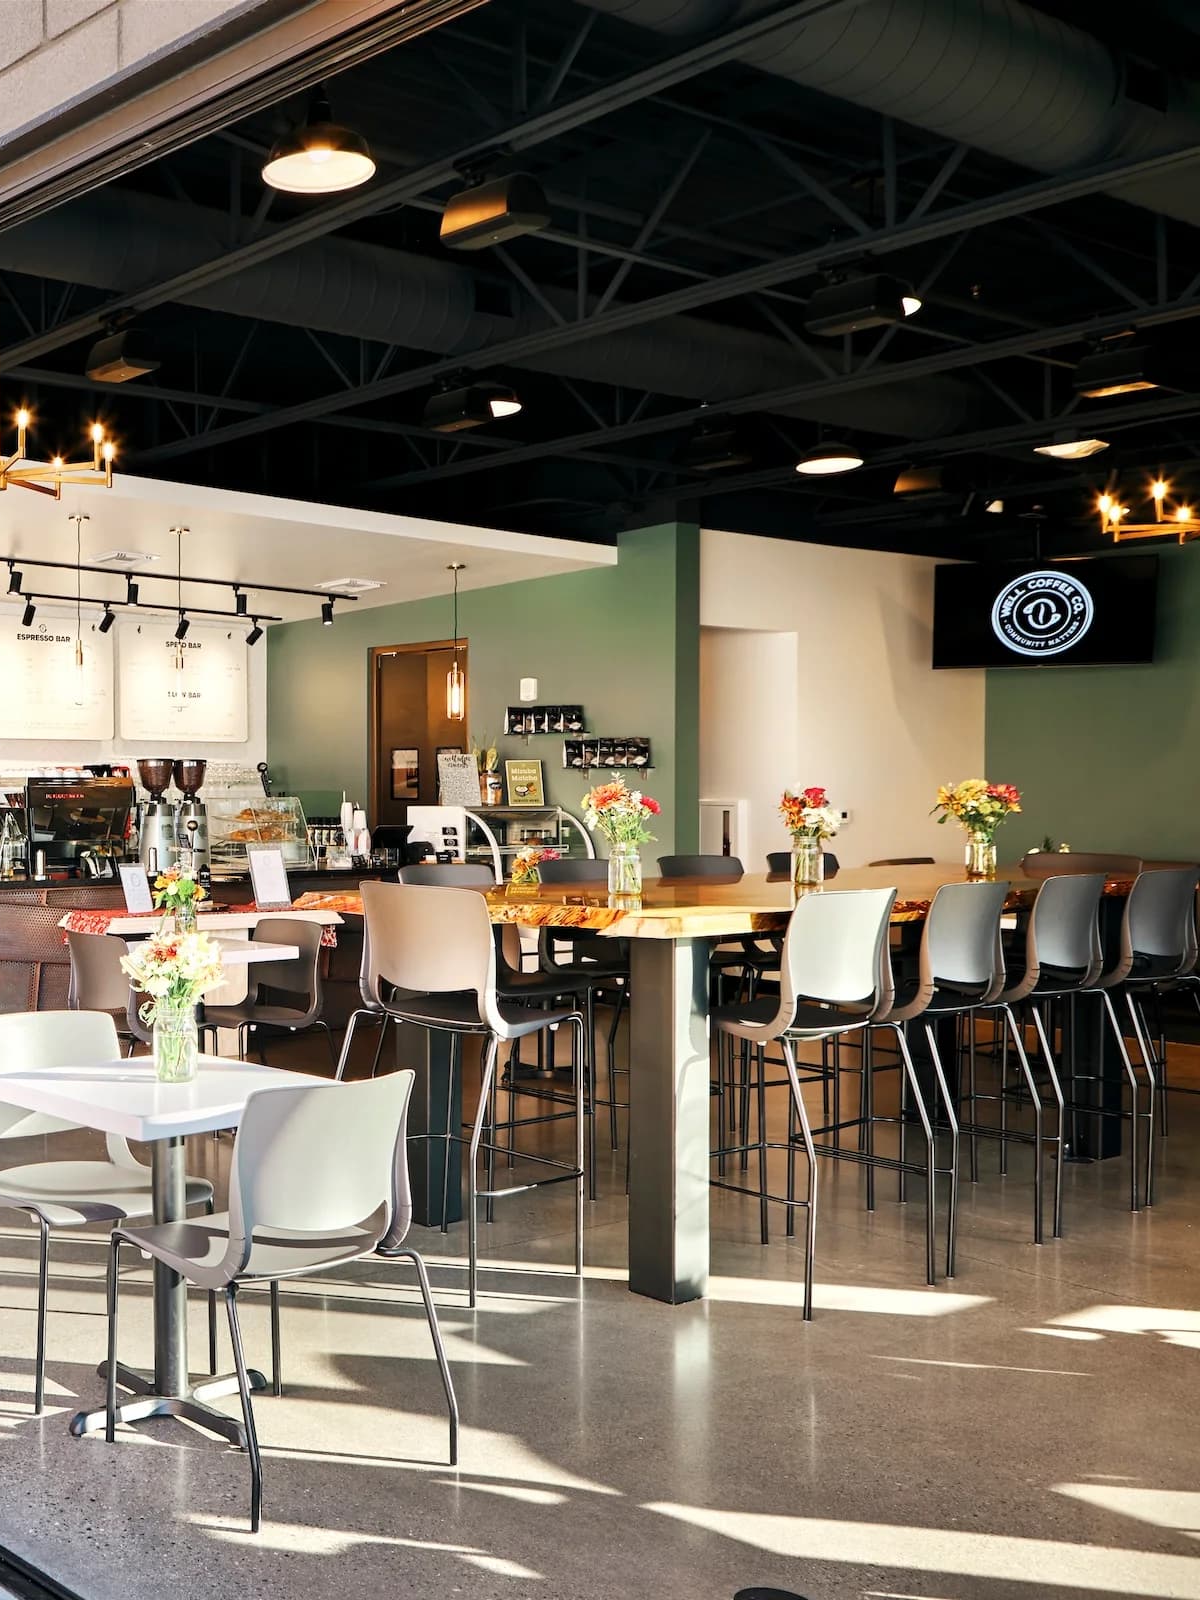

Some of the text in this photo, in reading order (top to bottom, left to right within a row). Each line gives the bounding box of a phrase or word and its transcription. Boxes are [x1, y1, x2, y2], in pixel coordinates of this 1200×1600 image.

[1000, 588, 1026, 618] WELL
[1027, 578, 1075, 597] COFFEE
[16, 633, 71, 643] ESPRESSO BAR
[1005, 621, 1080, 648] COMMUNITY MATTERS
[165, 641, 202, 649] SPED BAR
